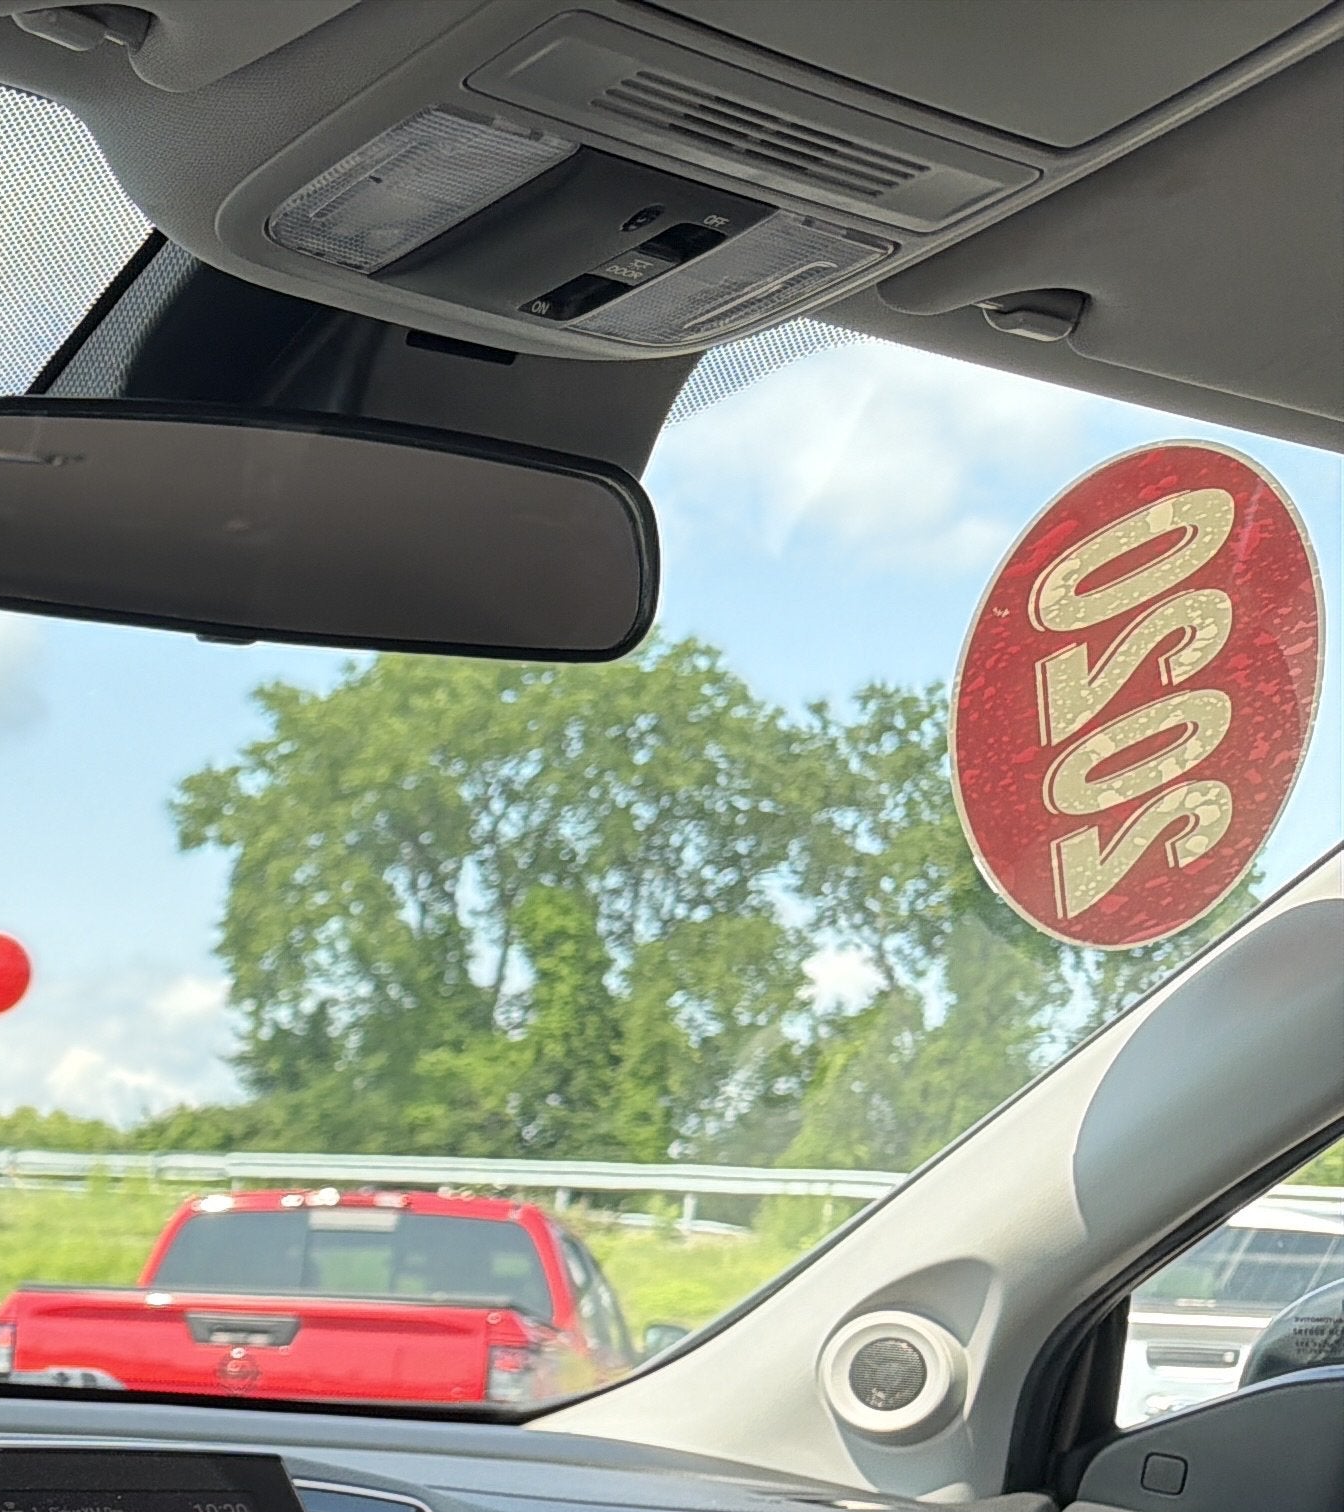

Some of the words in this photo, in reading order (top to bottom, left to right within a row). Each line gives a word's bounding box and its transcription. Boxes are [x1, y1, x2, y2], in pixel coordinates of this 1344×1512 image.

[703, 214, 730, 228] OFF
[605, 265, 645, 281] DOOR
[531, 300, 550, 315] ON
